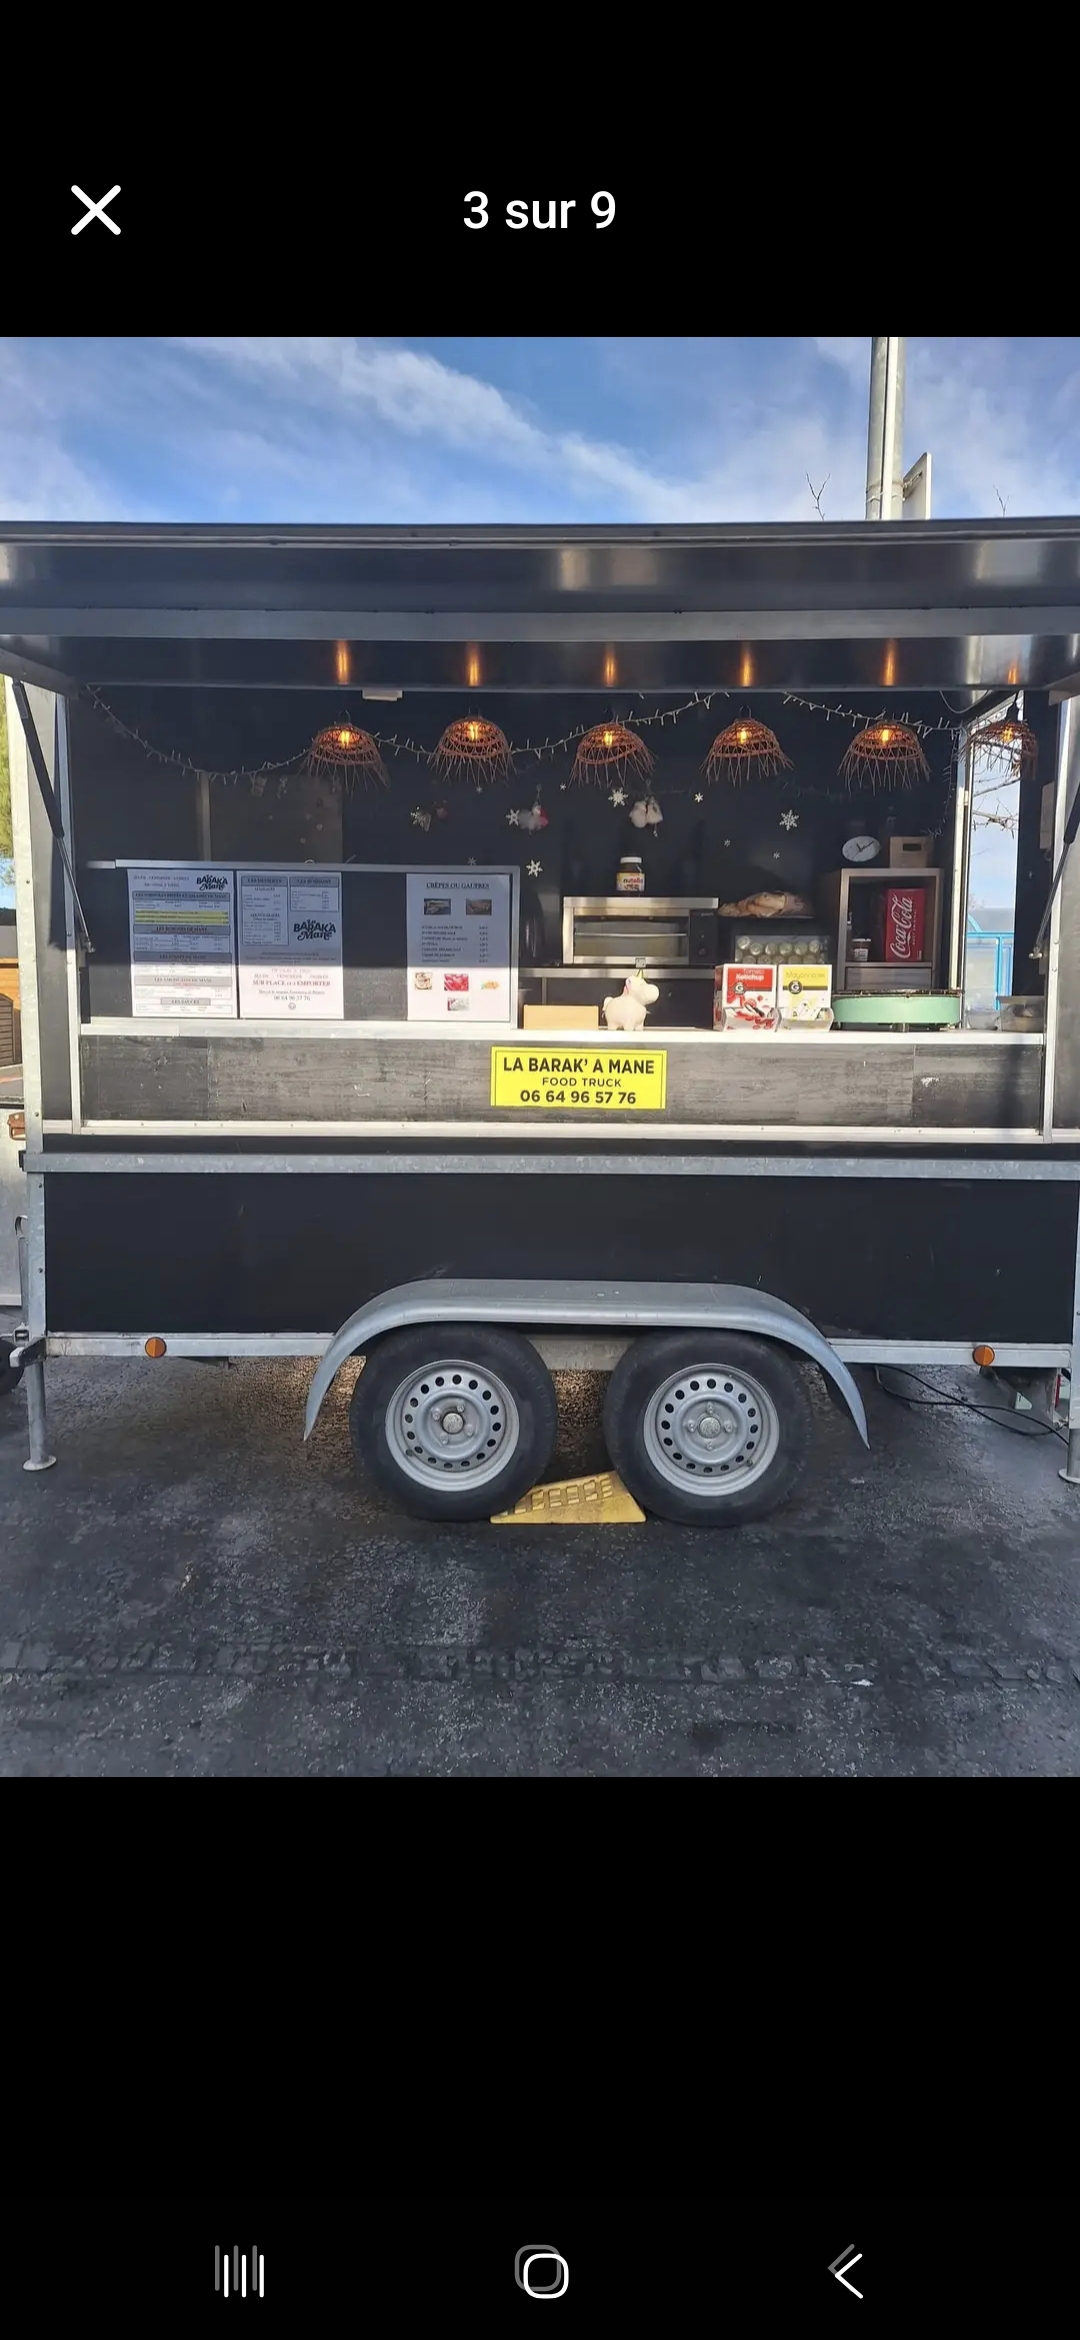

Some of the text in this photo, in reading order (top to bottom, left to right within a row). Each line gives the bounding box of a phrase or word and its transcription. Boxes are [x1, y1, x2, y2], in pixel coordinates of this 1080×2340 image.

[504, 1057, 523, 1072] LA
[593, 1059, 604, 1073] A
[609, 1060, 654, 1074] MANE
[542, 1077, 622, 1087] FOOD TRUCK
[520, 1090, 636, 1104] 06 64 96 57 76
